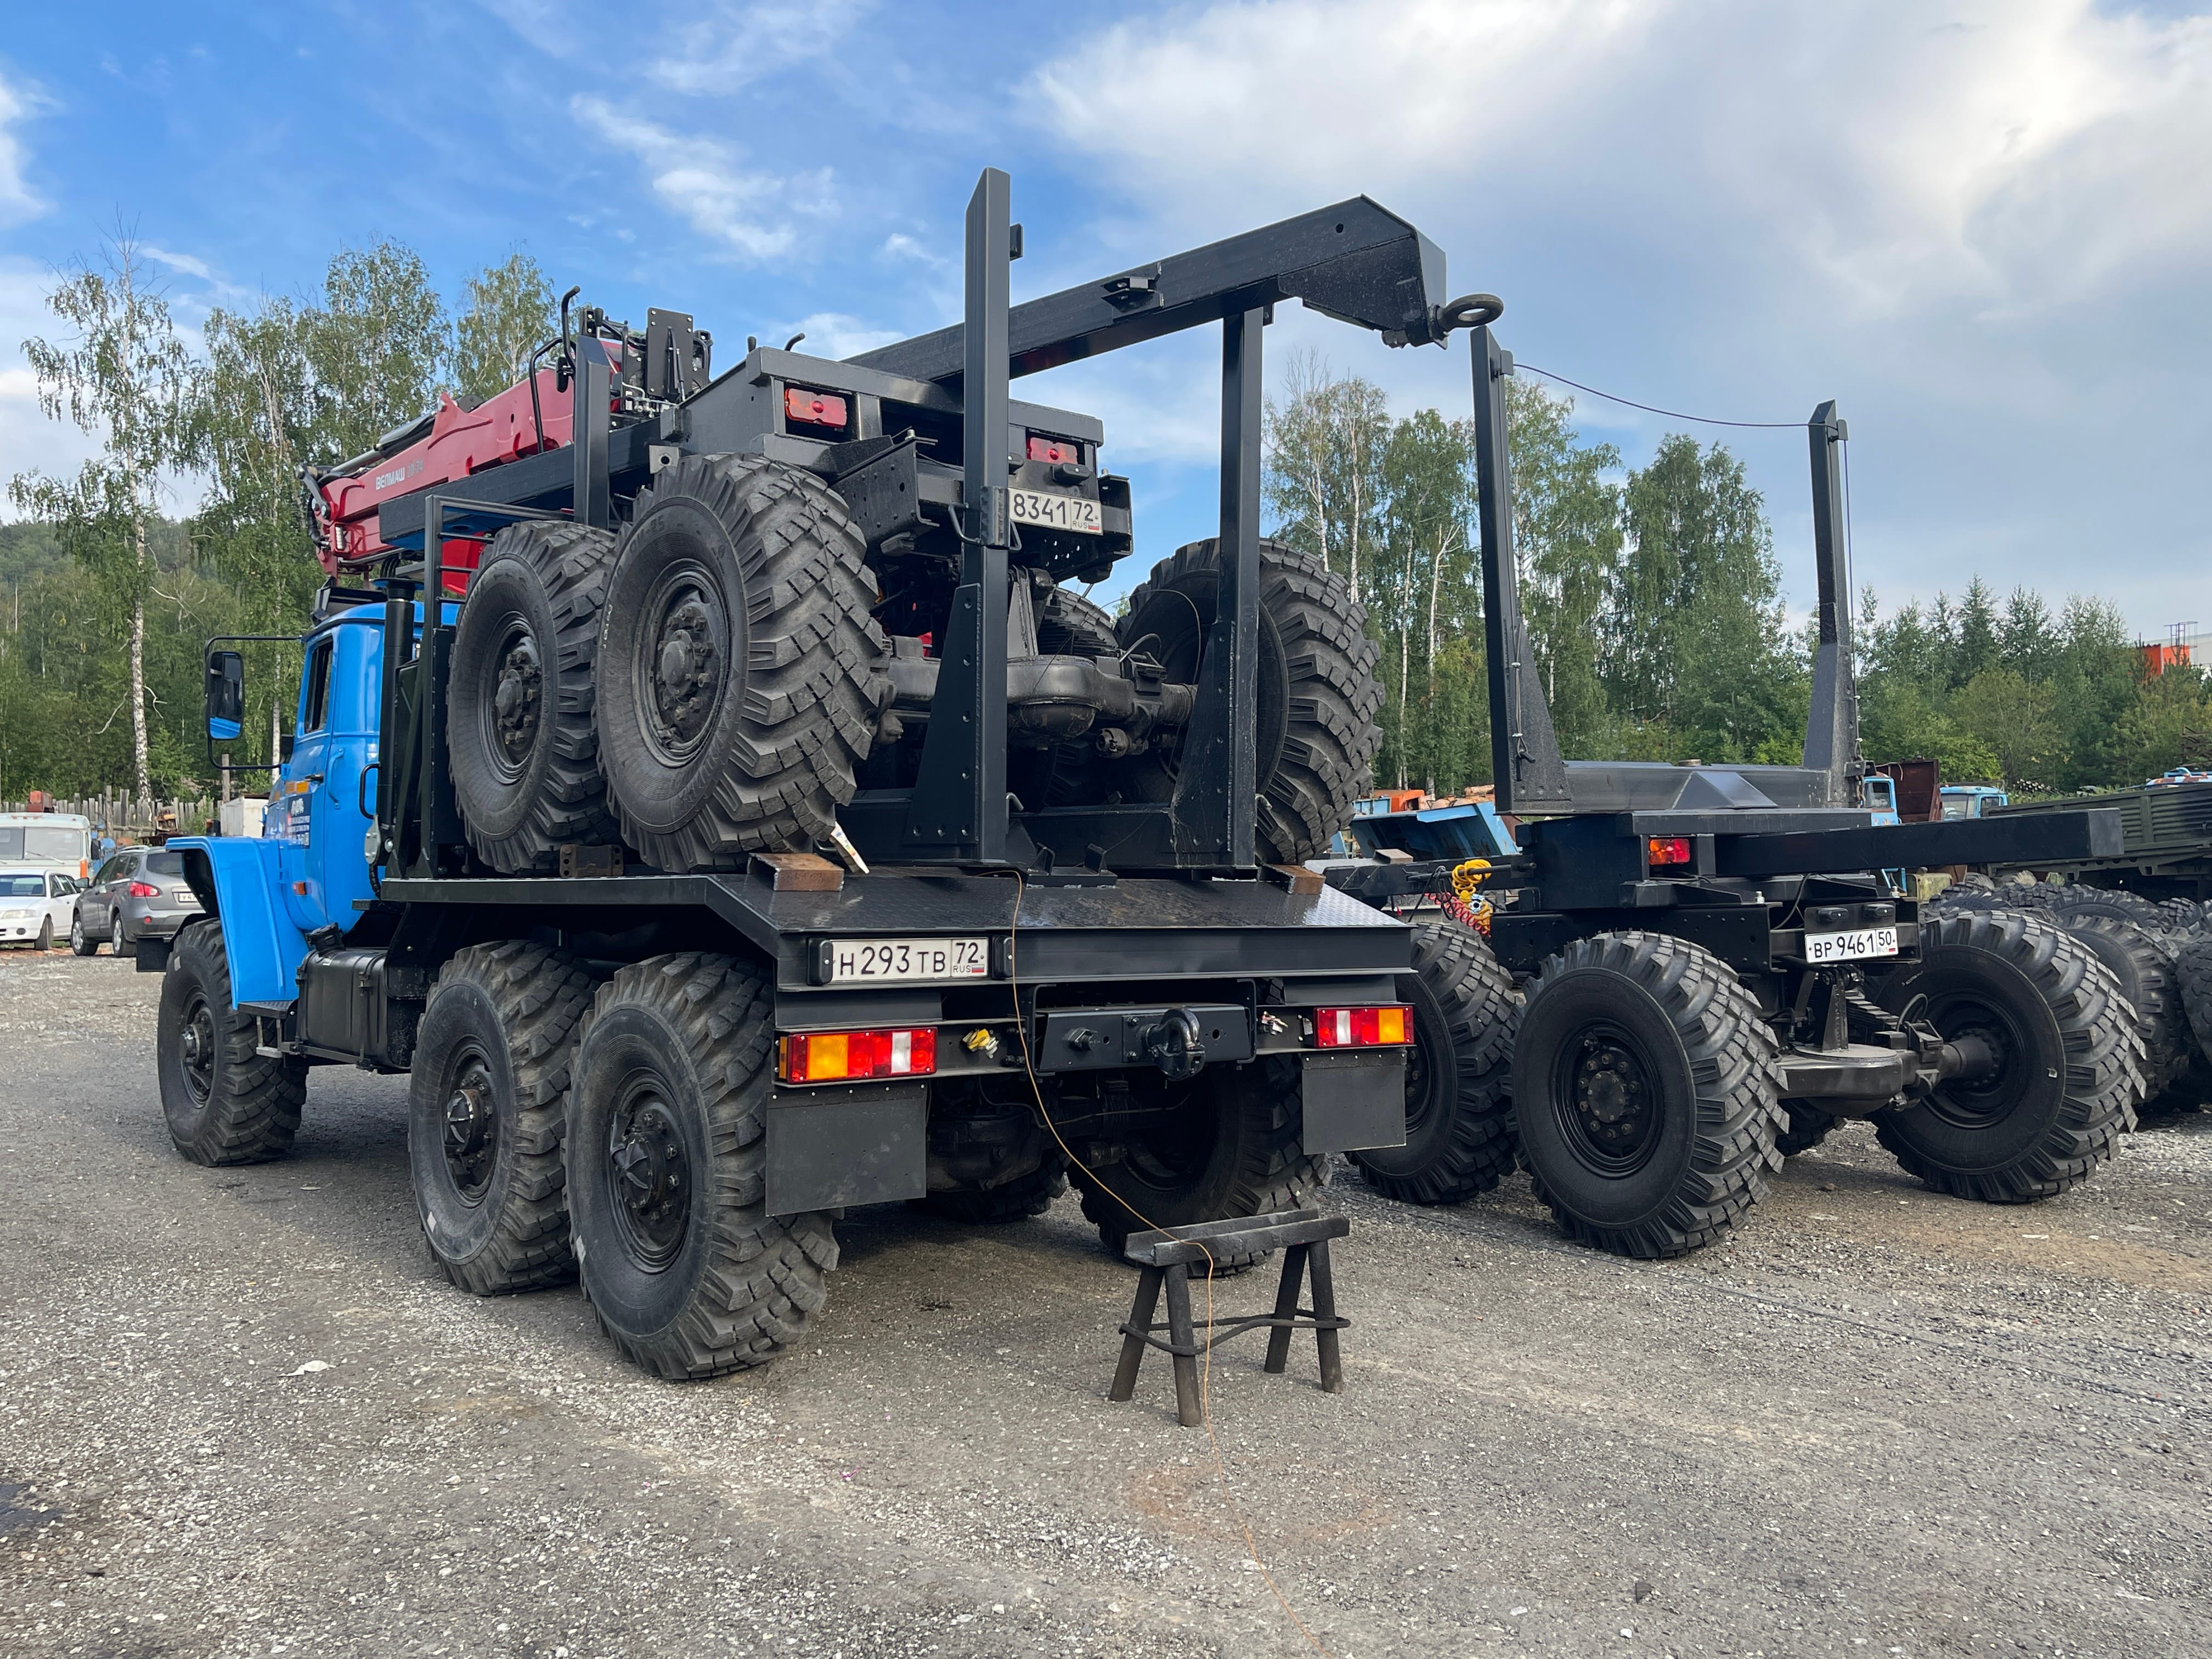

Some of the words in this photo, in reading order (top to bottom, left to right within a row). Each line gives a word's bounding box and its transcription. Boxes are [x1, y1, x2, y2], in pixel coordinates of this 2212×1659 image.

[1014, 493, 1066, 524] 8341
[1073, 501, 1093, 522] 72
[1073, 521, 1088, 529] RUS
[1878, 931, 1892, 946] 50
[956, 942, 979, 964] 72
